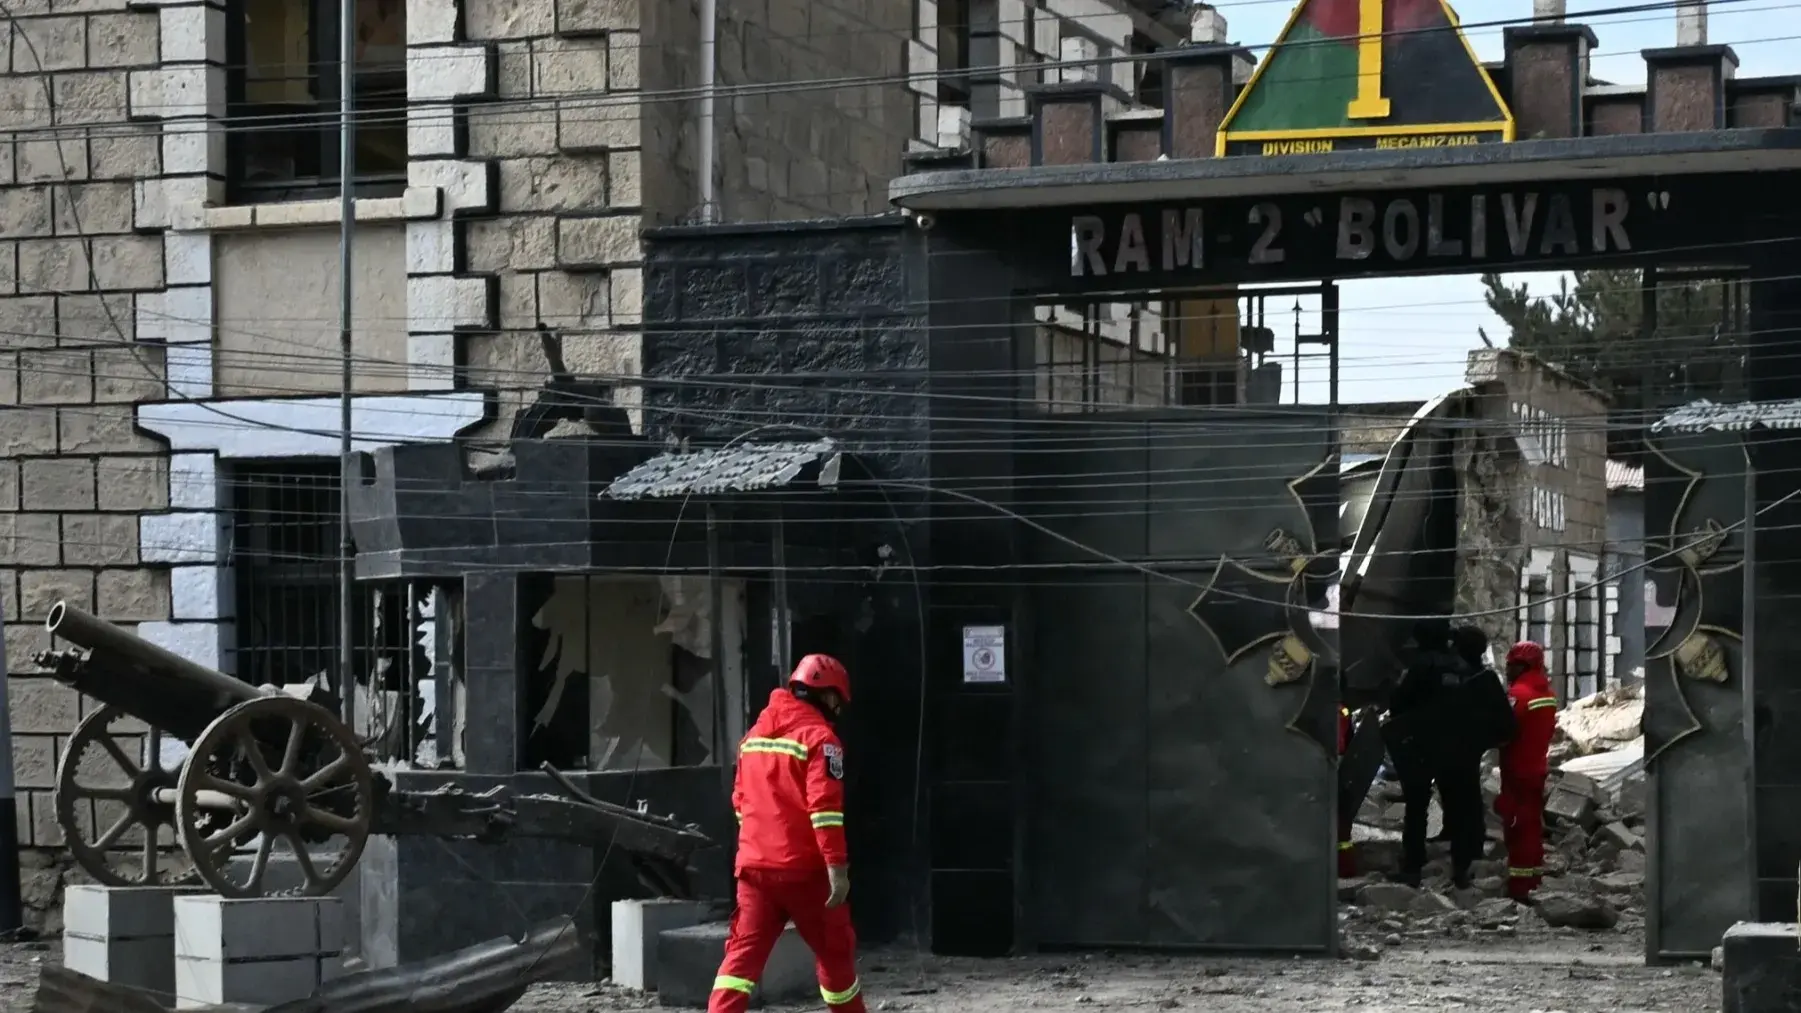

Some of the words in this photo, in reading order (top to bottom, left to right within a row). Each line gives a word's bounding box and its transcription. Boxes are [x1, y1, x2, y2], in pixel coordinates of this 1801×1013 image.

[1262, 140, 1334, 156] DIVISION
[1071, 208, 1204, 277] RAM
[1248, 202, 1286, 264] 2
